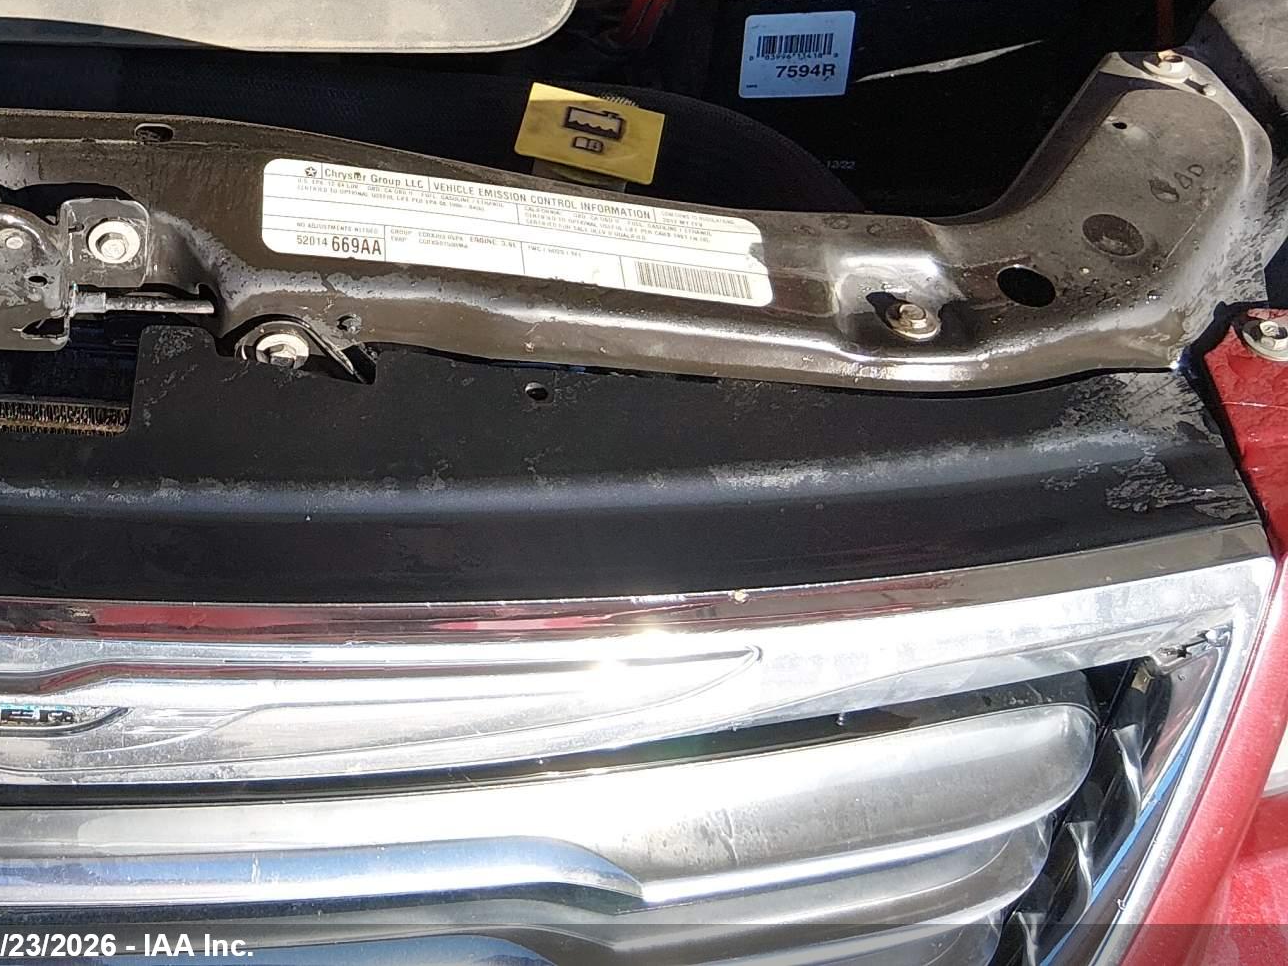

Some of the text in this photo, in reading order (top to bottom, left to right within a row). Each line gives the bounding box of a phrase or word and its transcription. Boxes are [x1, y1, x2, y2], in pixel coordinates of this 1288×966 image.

[775, 63, 836, 78] 7594R
[370, 173, 401, 187] Group
[405, 178, 424, 189] LLC
[433, 181, 478, 196] VEHICLE
[478, 187, 526, 202] EMISSION
[530, 194, 577, 210] CONTROL
[580, 201, 651, 220] INFORMATION
[296, 234, 382, 256] 52014 669AA
